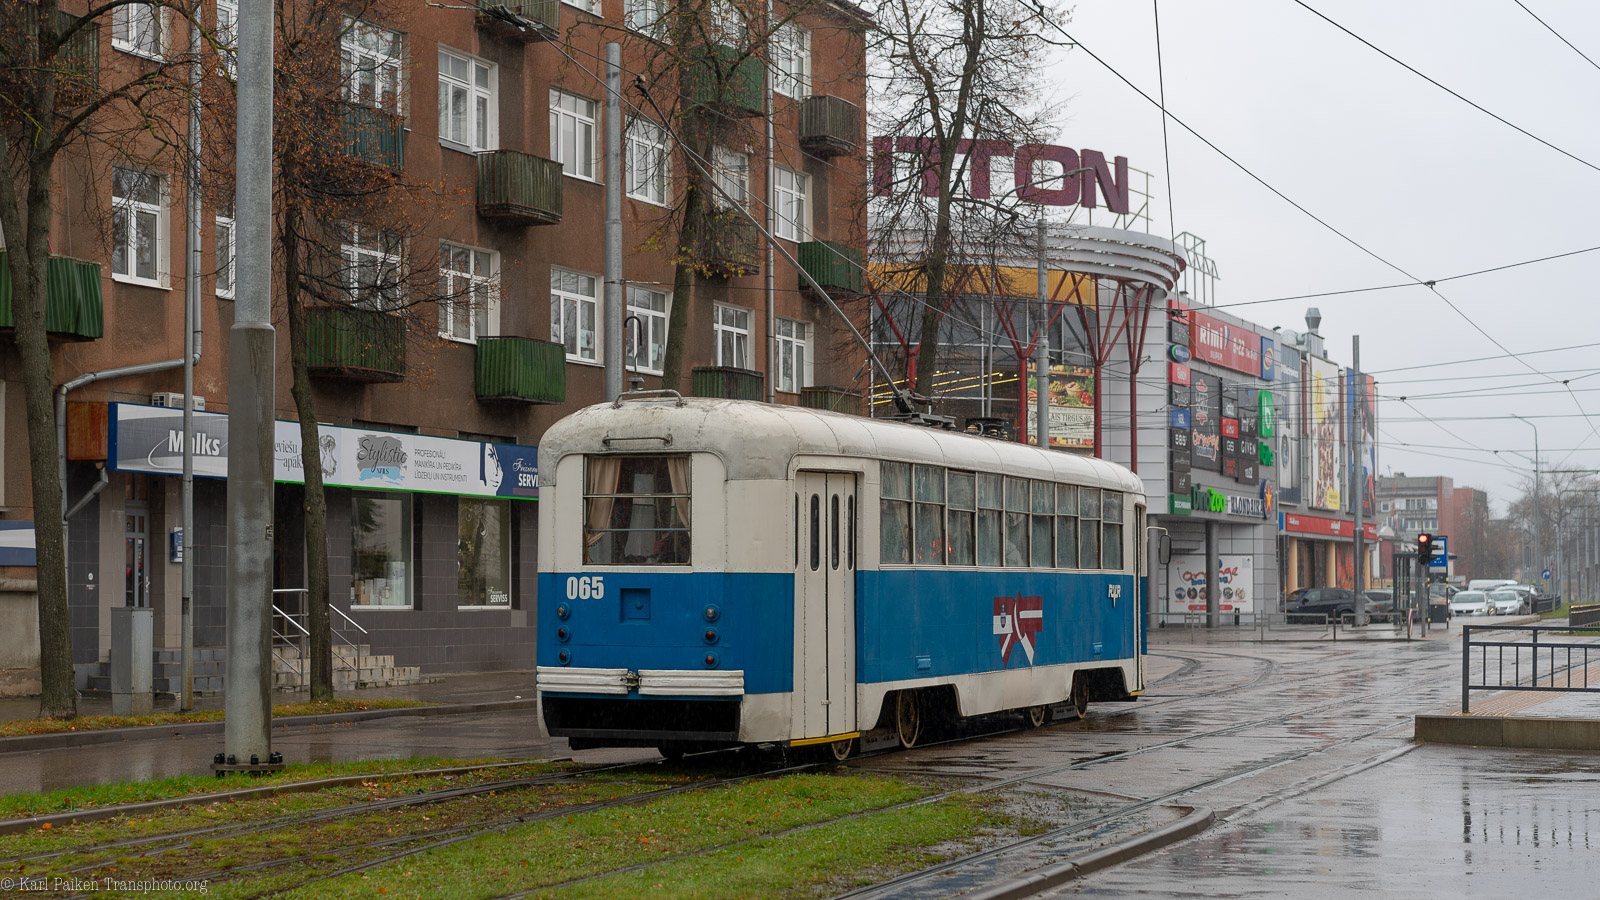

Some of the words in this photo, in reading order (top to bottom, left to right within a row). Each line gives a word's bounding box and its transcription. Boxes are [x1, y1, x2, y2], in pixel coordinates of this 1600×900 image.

[1062, 414, 1084, 422] TIRGUS
[273, 441, 298, 454] eviešu
[1240, 440, 1257, 456] GIVEN
[357, 438, 408, 473] Stylistic
[436, 462, 442, 470] UN
[442, 462, 462, 471] PEDIKĪRA
[433, 472, 440, 480] UN
[440, 473, 468, 482] INSTRUMENTI
[518, 473, 538, 487] SERVI
[566, 576, 604, 600] 065
[490, 594, 508, 603] SERVISS
